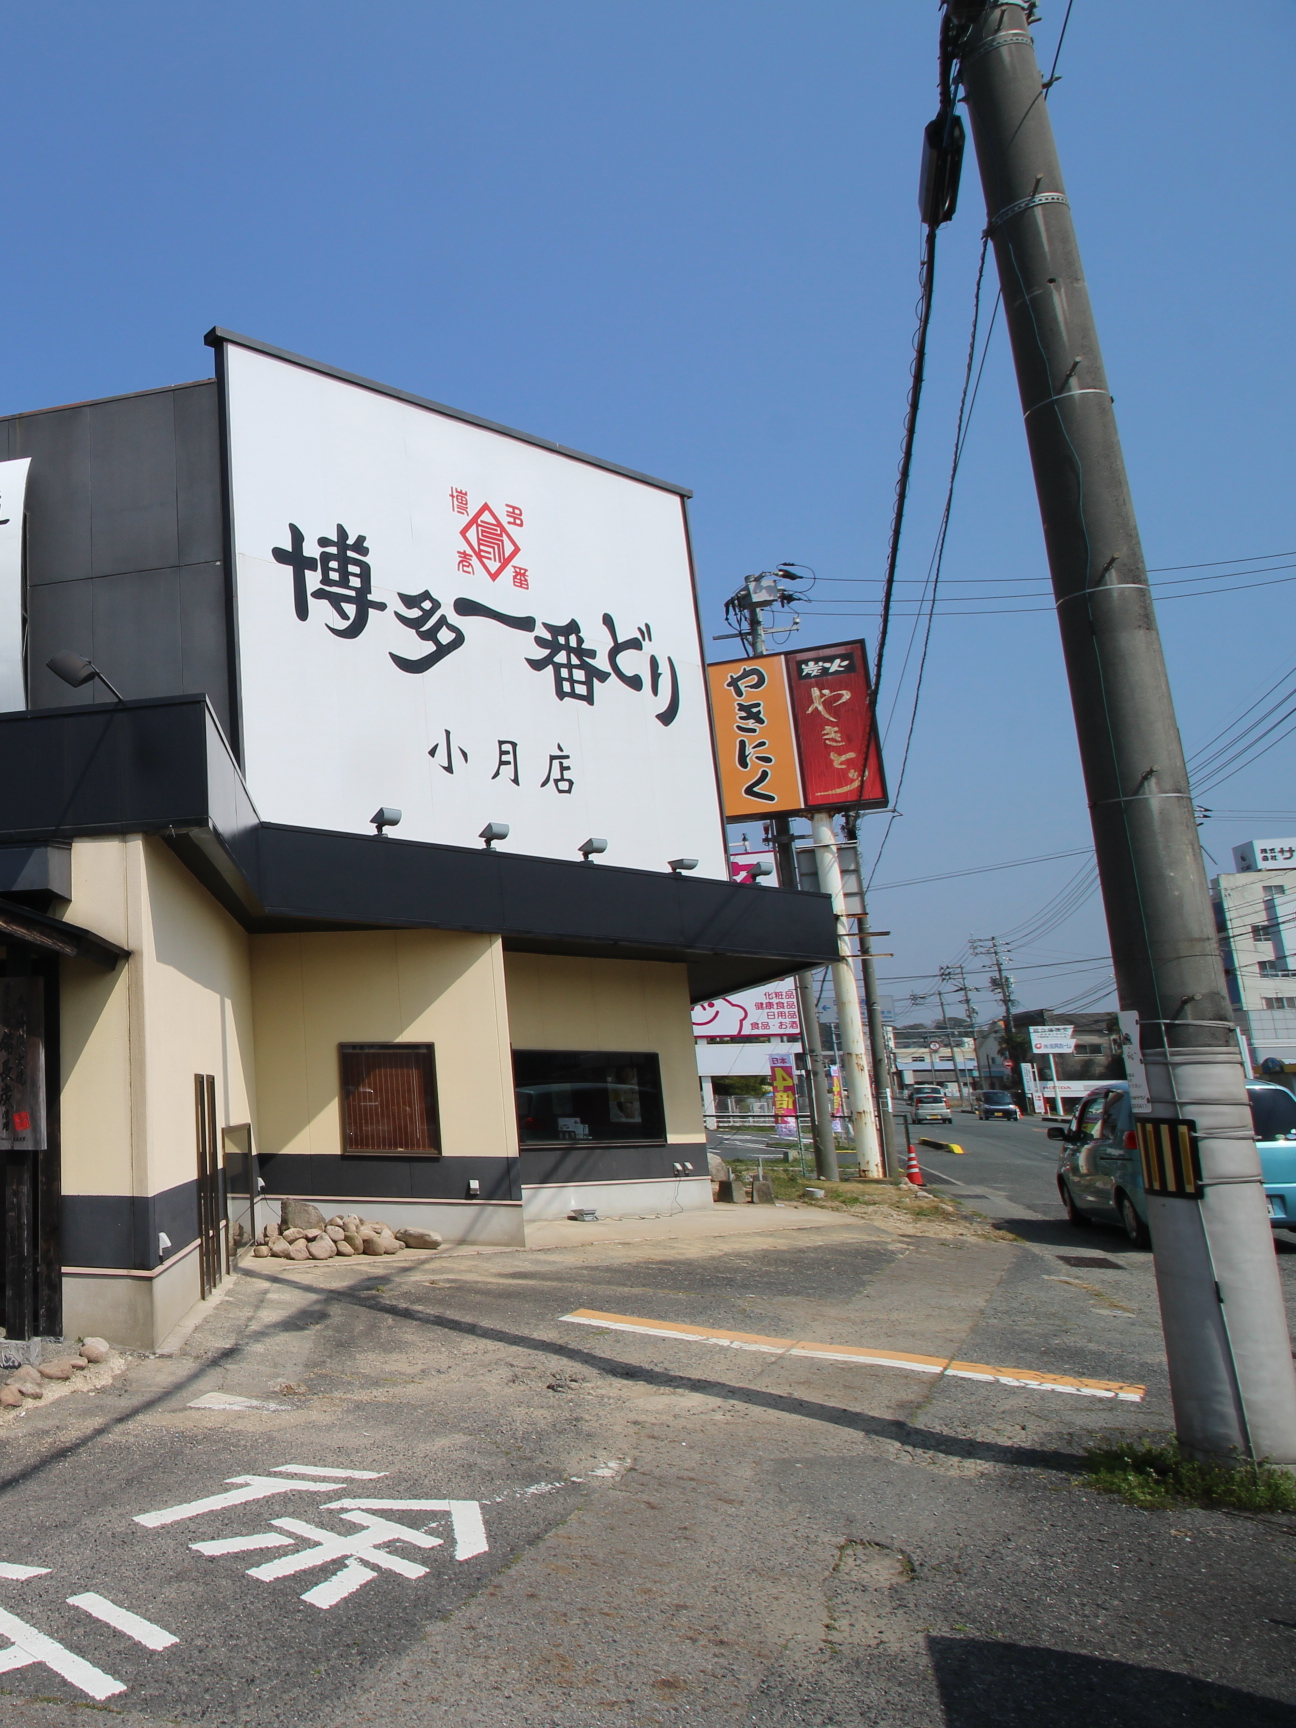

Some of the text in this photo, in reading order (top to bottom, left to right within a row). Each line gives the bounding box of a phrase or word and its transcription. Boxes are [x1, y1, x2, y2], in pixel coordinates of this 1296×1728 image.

[271, 522, 681, 727] 博多一番どり
[801, 658, 850, 677] 炭火
[724, 665, 778, 804] やきにく
[806, 687, 870, 797] やきとり
[427, 729, 576, 795] 小月店
[755, 1001, 796, 1010] 健康食品
[764, 991, 795, 1000] 化粧品
[766, 1010, 797, 1020] 日用品
